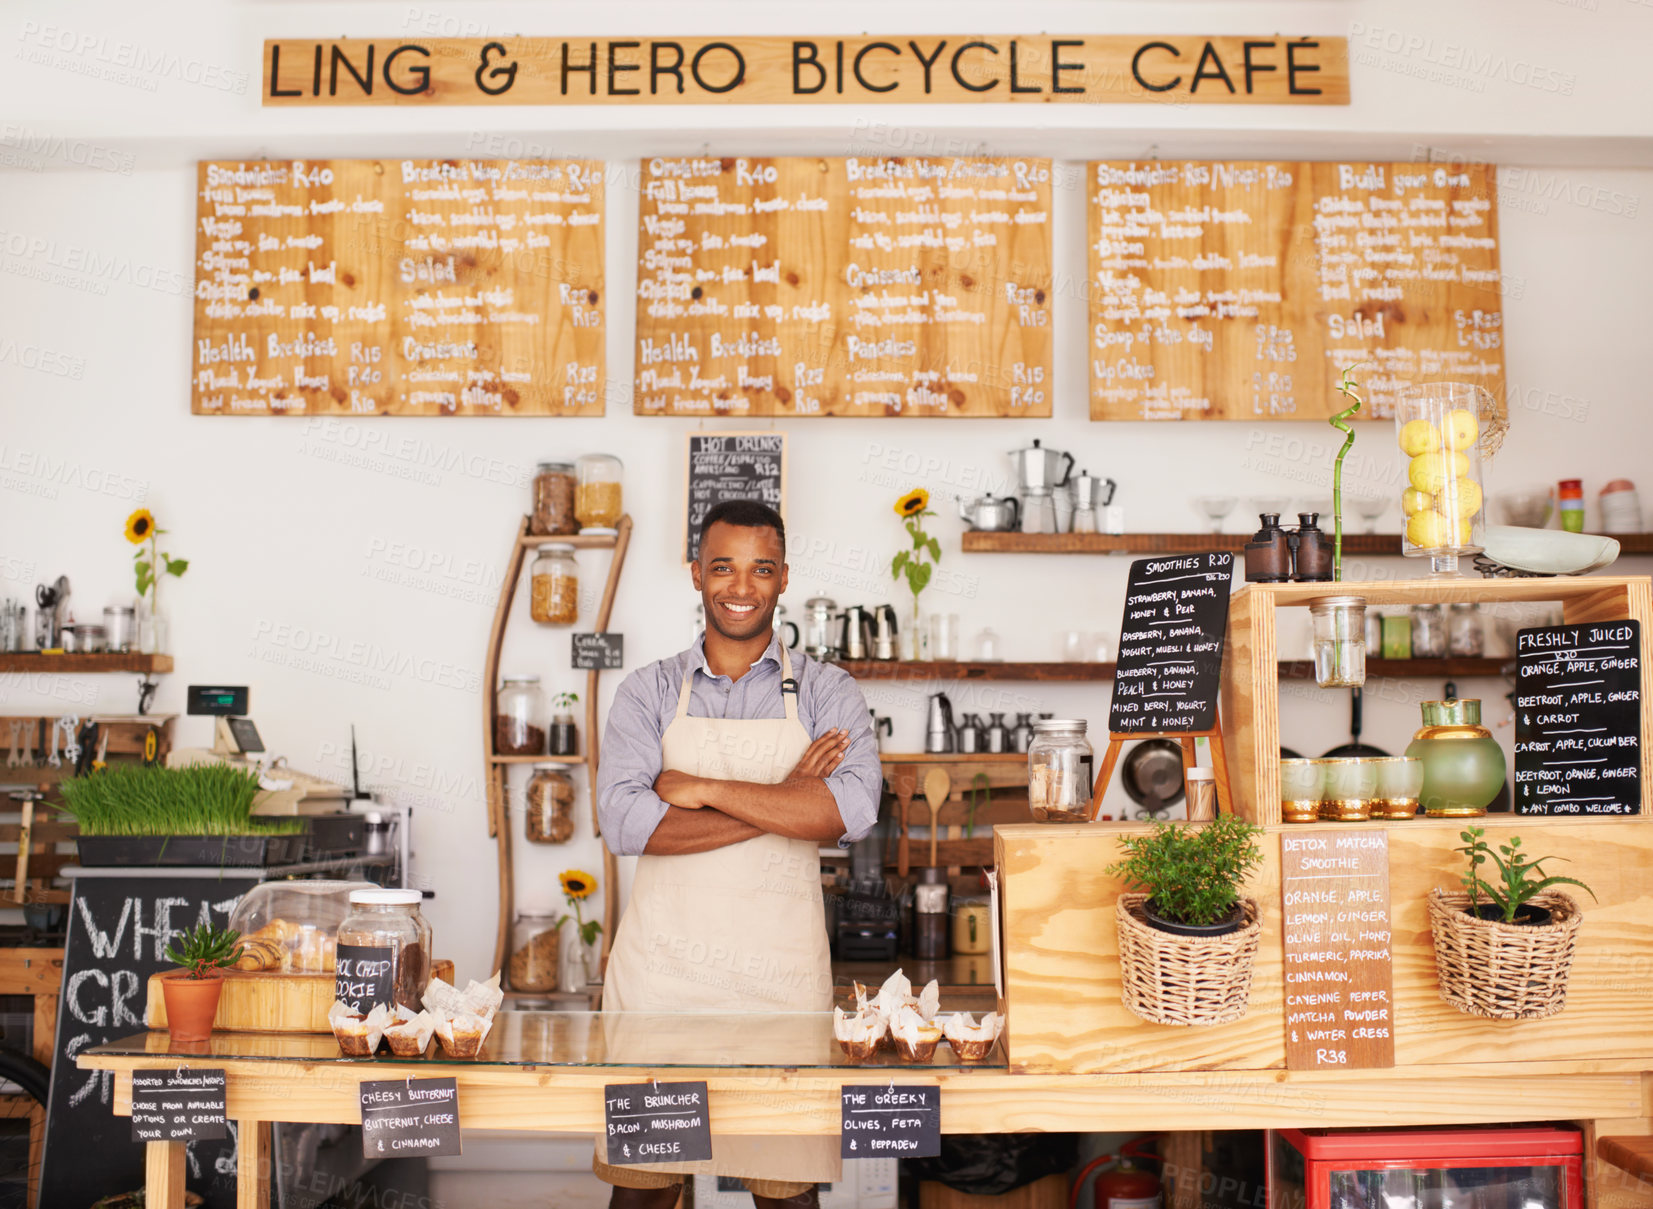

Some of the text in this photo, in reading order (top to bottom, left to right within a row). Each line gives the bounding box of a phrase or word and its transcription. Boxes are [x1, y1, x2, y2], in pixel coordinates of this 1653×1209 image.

[270, 37, 1322, 96] LING & HERO BICYCLE CAFÉ
[293, 161, 334, 188] R40
[736, 159, 778, 186] R40
[1339, 165, 1385, 190] Build
[1434, 168, 1470, 188] Own
[400, 256, 456, 284] Salad
[1328, 311, 1385, 340] Salad
[1095, 324, 1134, 352] Soup
[198, 333, 255, 364] Health
[641, 333, 698, 364] Health
[1145, 554, 1230, 575] SMOOTHIES R20
[1128, 587, 1216, 605] STRAWBERRY, BANANA,
[1130, 608, 1156, 619] HONEY
[1122, 625, 1204, 642] RASPBERRY, BANANA,
[1519, 627, 1633, 650] FRESHLY JUICED
[1121, 647, 1155, 658] YOGURT,
[1156, 643, 1183, 653] MUESLI
[1193, 642, 1219, 652] HONEY
[1116, 665, 1199, 679] BLUEBERRY, BANANA,
[1521, 658, 1638, 677] ORANGE, APPLE, GINGER
[1118, 682, 1144, 695] PEACH
[1162, 680, 1194, 689] HONEY
[1518, 691, 1639, 707] BEETROOT, APPLE, GINGER
[1112, 703, 1138, 713] MIXED
[1176, 701, 1206, 712] YOGURT,
[1120, 716, 1146, 727] MINT
[1162, 716, 1194, 726] HONEY
[1536, 713, 1579, 725] CARROT
[1515, 736, 1638, 753] CARROT, APPLE, CUCUMBER
[1515, 770, 1564, 782] BEETROOT,
[1565, 768, 1600, 780] ORANGE,
[1536, 783, 1570, 794] LEMON
[1554, 803, 1580, 813] COMBO
[1284, 837, 1385, 852] DETOX MATCHA
[1300, 857, 1360, 870] SMOOTHIE
[1284, 890, 1344, 906] ORANGE,
[1286, 912, 1334, 924] LEMON,
[1286, 930, 1391, 944] OLIVE OIL, HONEY
[1286, 948, 1391, 963] TURMERIC, PAPRIKA,
[1287, 971, 1352, 983] CINNAMON,
[1287, 992, 1340, 1005] CAYENNE
[1288, 1009, 1388, 1025] MATCHA POWDER
[1291, 1027, 1389, 1042] & WATER CRESS
[1316, 1048, 1346, 1064] R38
[362, 1088, 455, 1104] CHEESY BUTTERNUT
[606, 1092, 700, 1111] THE BRUNCHER
[843, 1093, 926, 1105] THE GREEKY
[132, 1102, 157, 1110] CHOOSE
[133, 1115, 224, 1123] OPTIONS OR CREATE
[365, 1113, 453, 1131] BUTTERNUT, CHEESE
[651, 1117, 701, 1130] MUSHROOM
[844, 1118, 921, 1132] OLIVES, FETA
[137, 1130, 161, 1138] YOUR
[392, 1138, 440, 1149] CINNAMON
[638, 1142, 680, 1155] CHEESE
[871, 1139, 918, 1150] PEPPADEW
